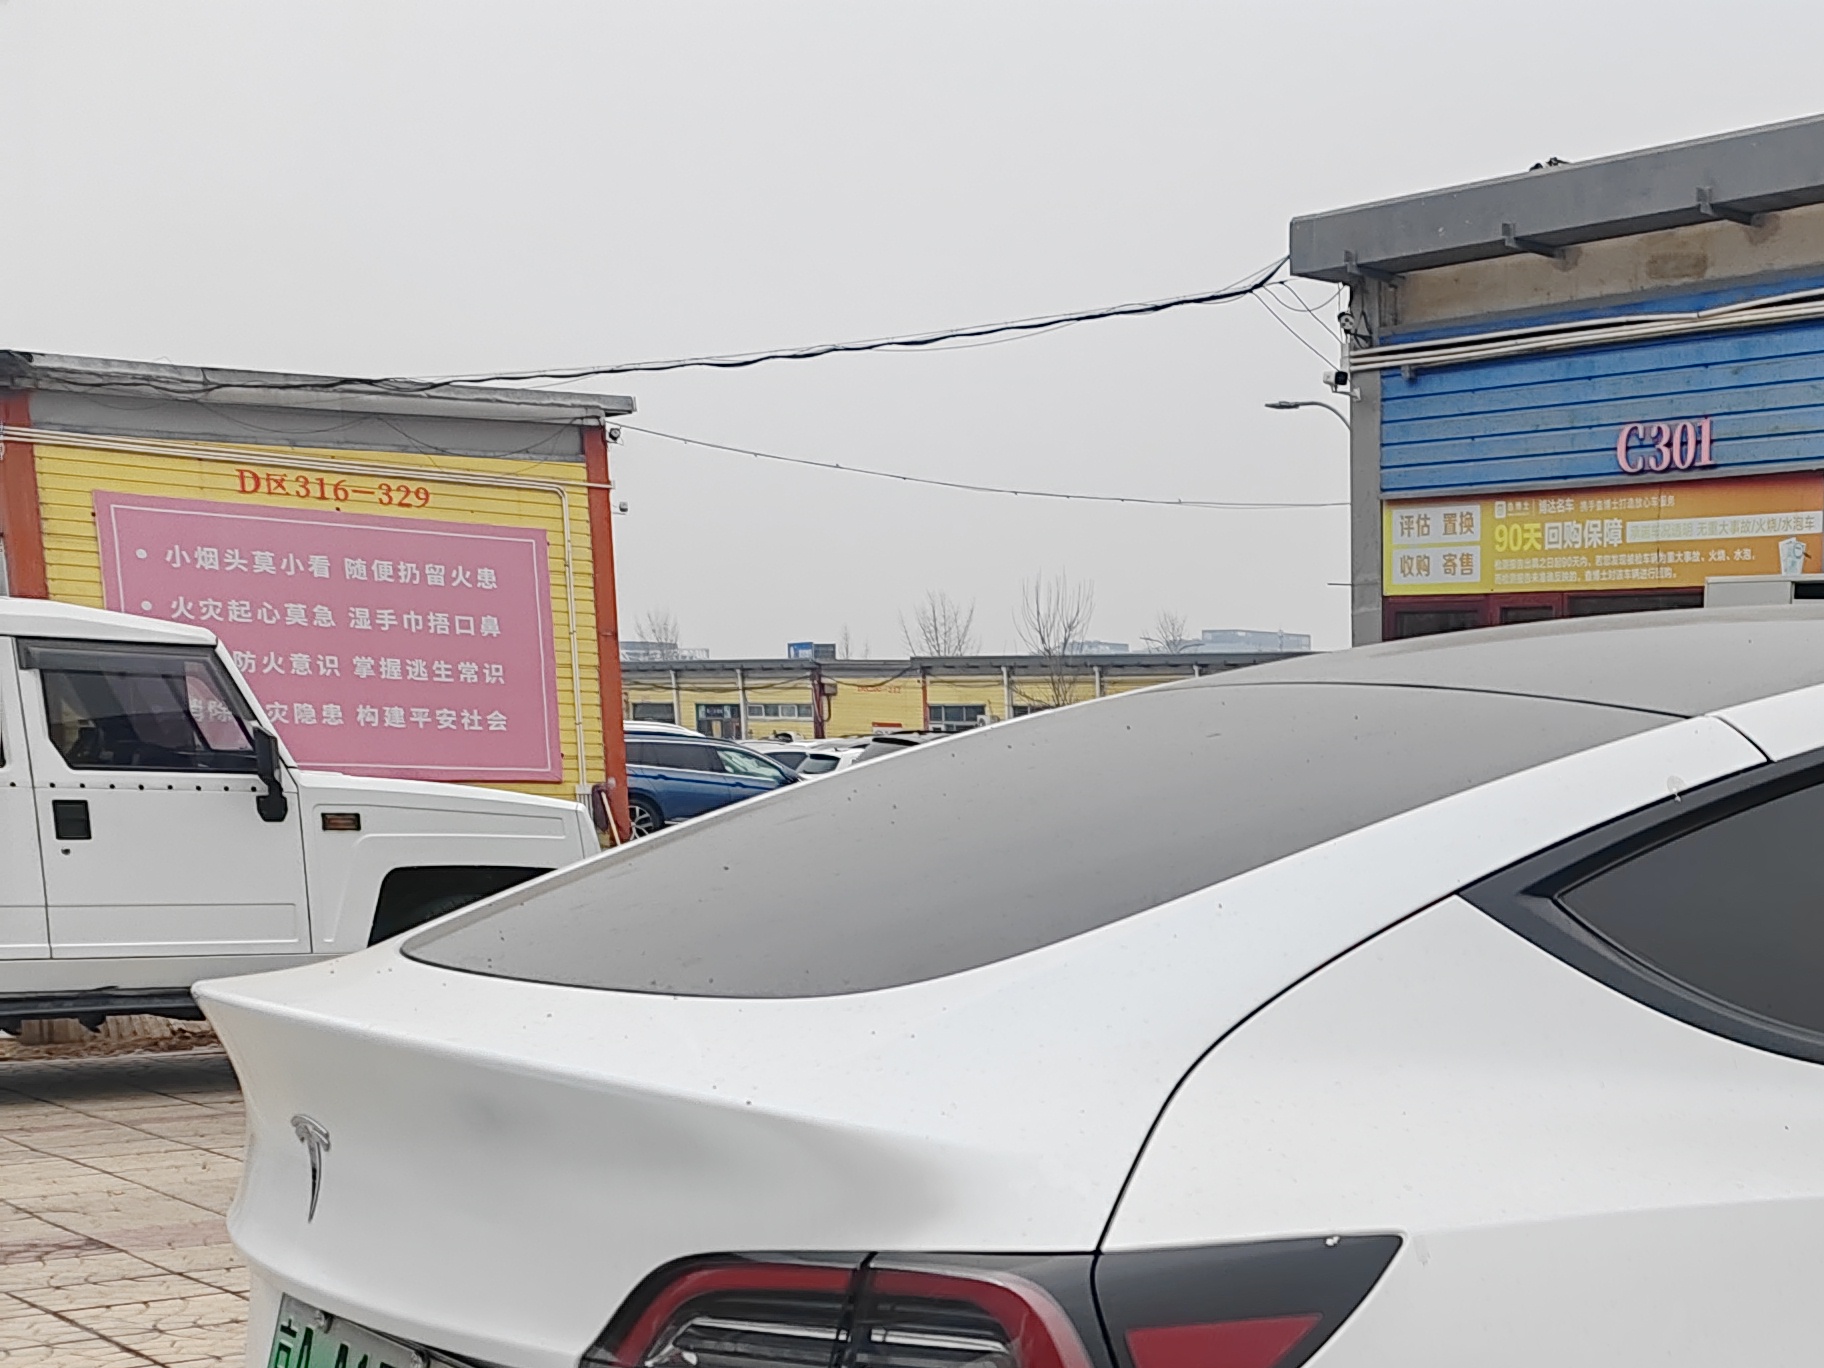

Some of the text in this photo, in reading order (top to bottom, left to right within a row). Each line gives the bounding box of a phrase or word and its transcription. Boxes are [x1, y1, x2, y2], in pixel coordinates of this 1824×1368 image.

[1617, 418, 1717, 473] C301
[1399, 511, 1475, 538] 评估 置换
[165, 545, 498, 590] 小烟头莫小看 随便扔留火患
[1399, 552, 1474, 578] 收购 寄售
[171, 596, 501, 637] 火灾起心莫急 湿手巾捂口鼻
[353, 656, 505, 684] 掌握逃生常识
[357, 704, 507, 731] 构建平安社会
